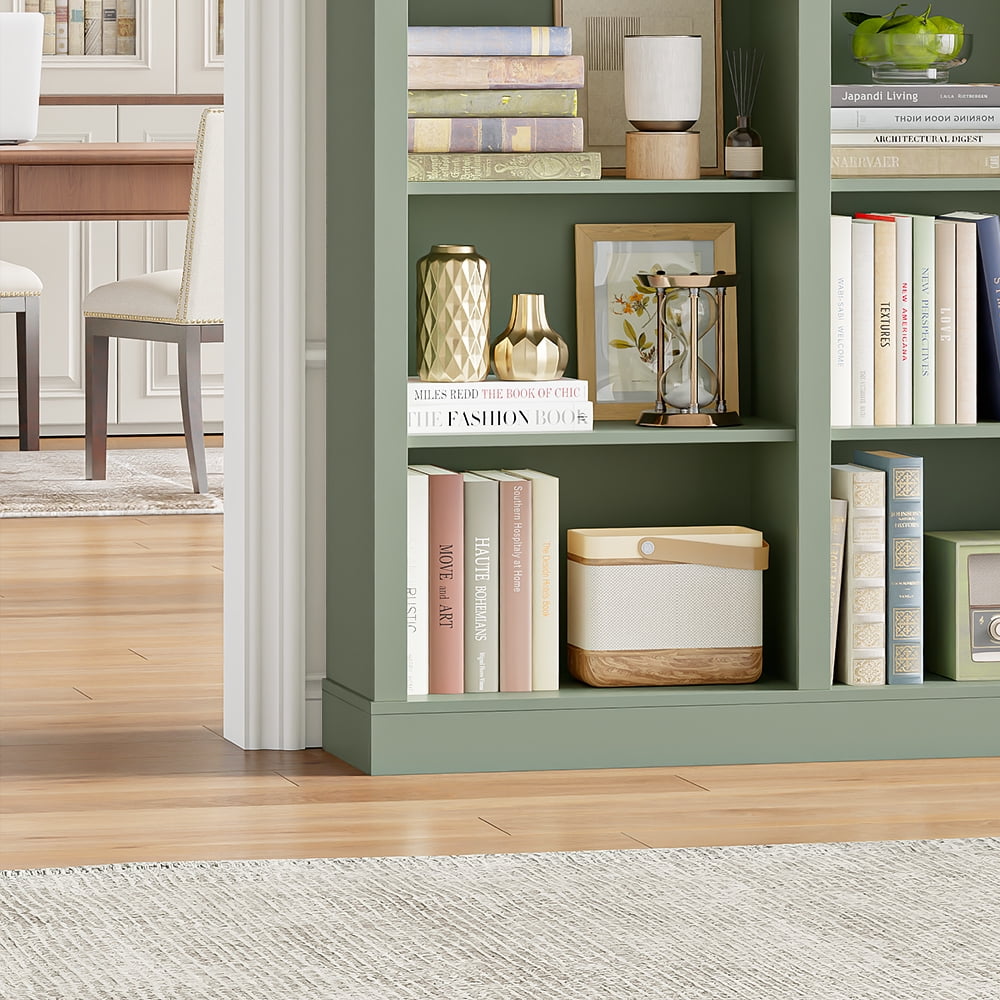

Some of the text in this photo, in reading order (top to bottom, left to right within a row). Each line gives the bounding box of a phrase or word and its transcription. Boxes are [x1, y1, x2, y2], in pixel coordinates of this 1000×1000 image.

[842, 91, 919, 102] Japandi Living
[873, 135, 983, 143] ARCHITECTURAL DIGEST
[837, 276, 845, 368] WABI-SABI WELCOME
[880, 302, 891, 348] TEXTURES
[921, 267, 930, 378] NEW PERSPECTIVES
[940, 307, 951, 342] LOVE
[414, 386, 581, 400] MILES REDD THE BOOK OF CHIC
[447, 410, 530, 427] FASHION
[513, 485, 523, 520] Southern
[474, 536, 490, 581] HAUTE
[514, 560, 522, 568] at
[439, 544, 454, 629] MOVE and ART
[512, 570, 522, 593] Home
[474, 585, 487, 642] BOHEMIANS
